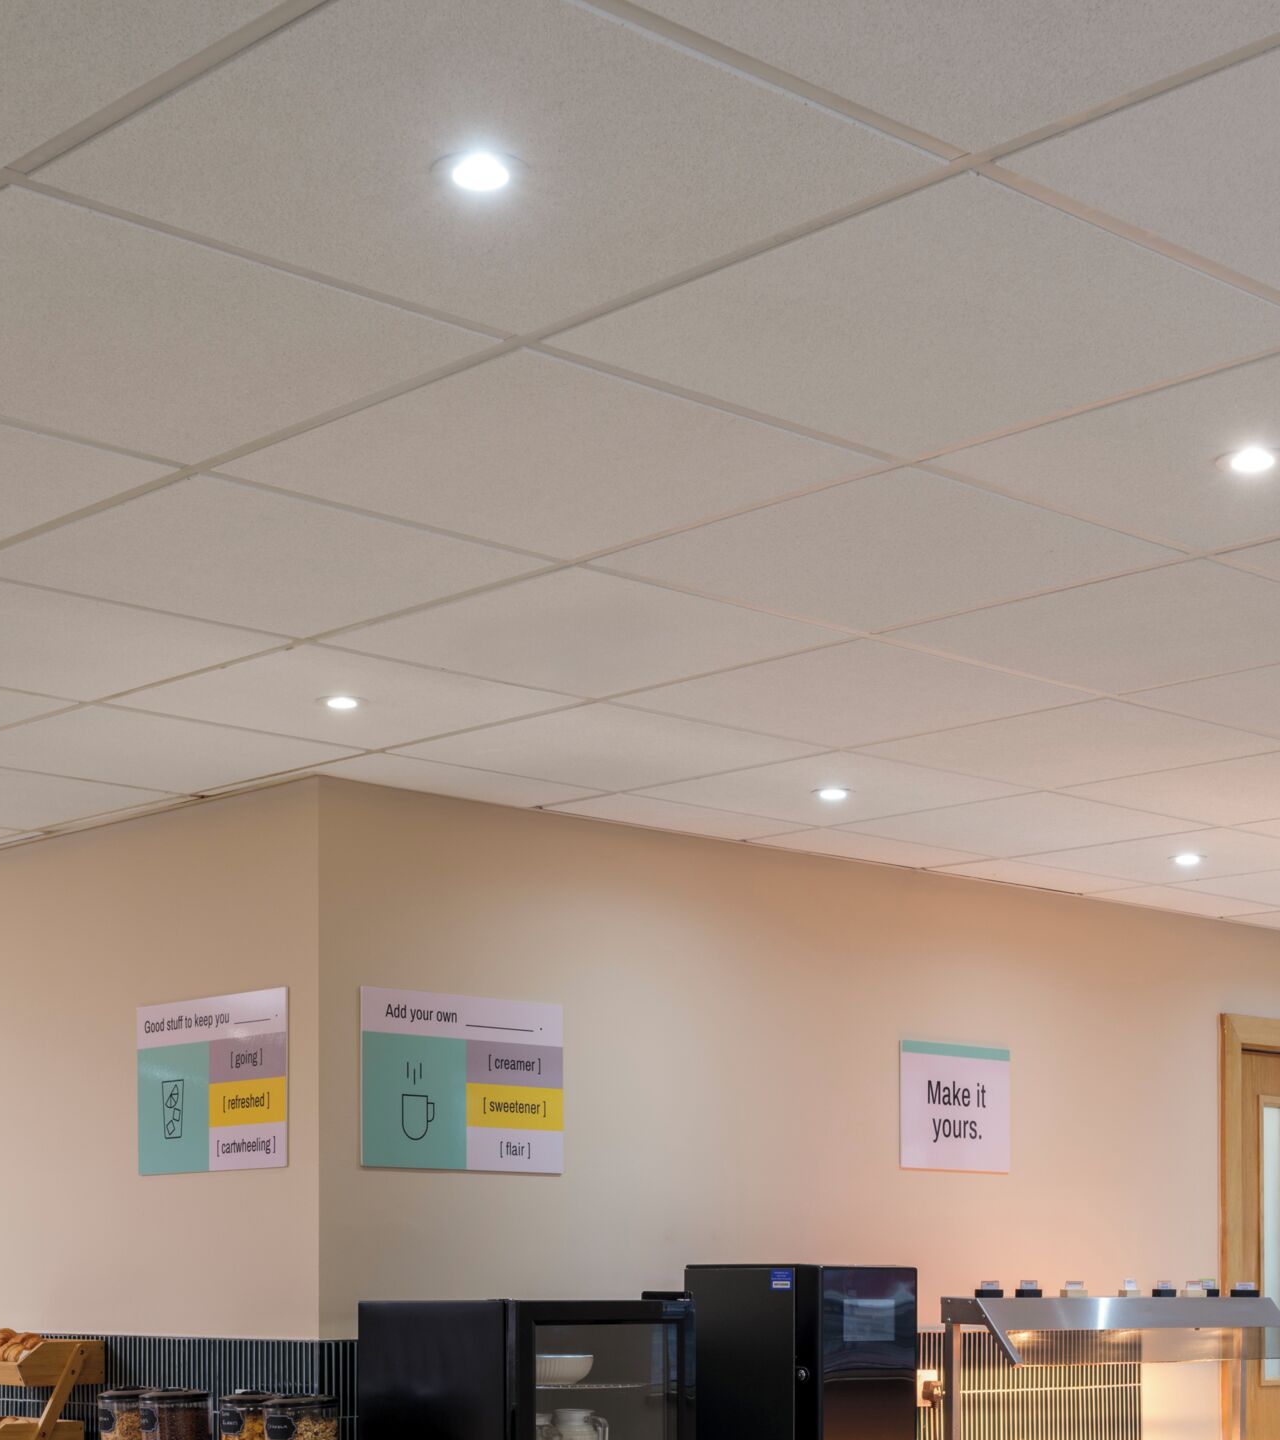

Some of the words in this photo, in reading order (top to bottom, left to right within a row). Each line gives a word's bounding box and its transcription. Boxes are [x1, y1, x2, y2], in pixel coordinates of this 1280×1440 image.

[144, 1015, 164, 1034] Good
[167, 1014, 183, 1031] stuff
[185, 1016, 192, 1028] to
[194, 1013, 213, 1030] keep
[215, 1013, 229, 1027] you
[386, 1003, 406, 1018] Add
[410, 1008, 433, 1023] your
[436, 1010, 457, 1023] own
[927, 1080, 970, 1107] Make
[977, 1083, 986, 1108] it
[932, 1118, 982, 1142] yours.
